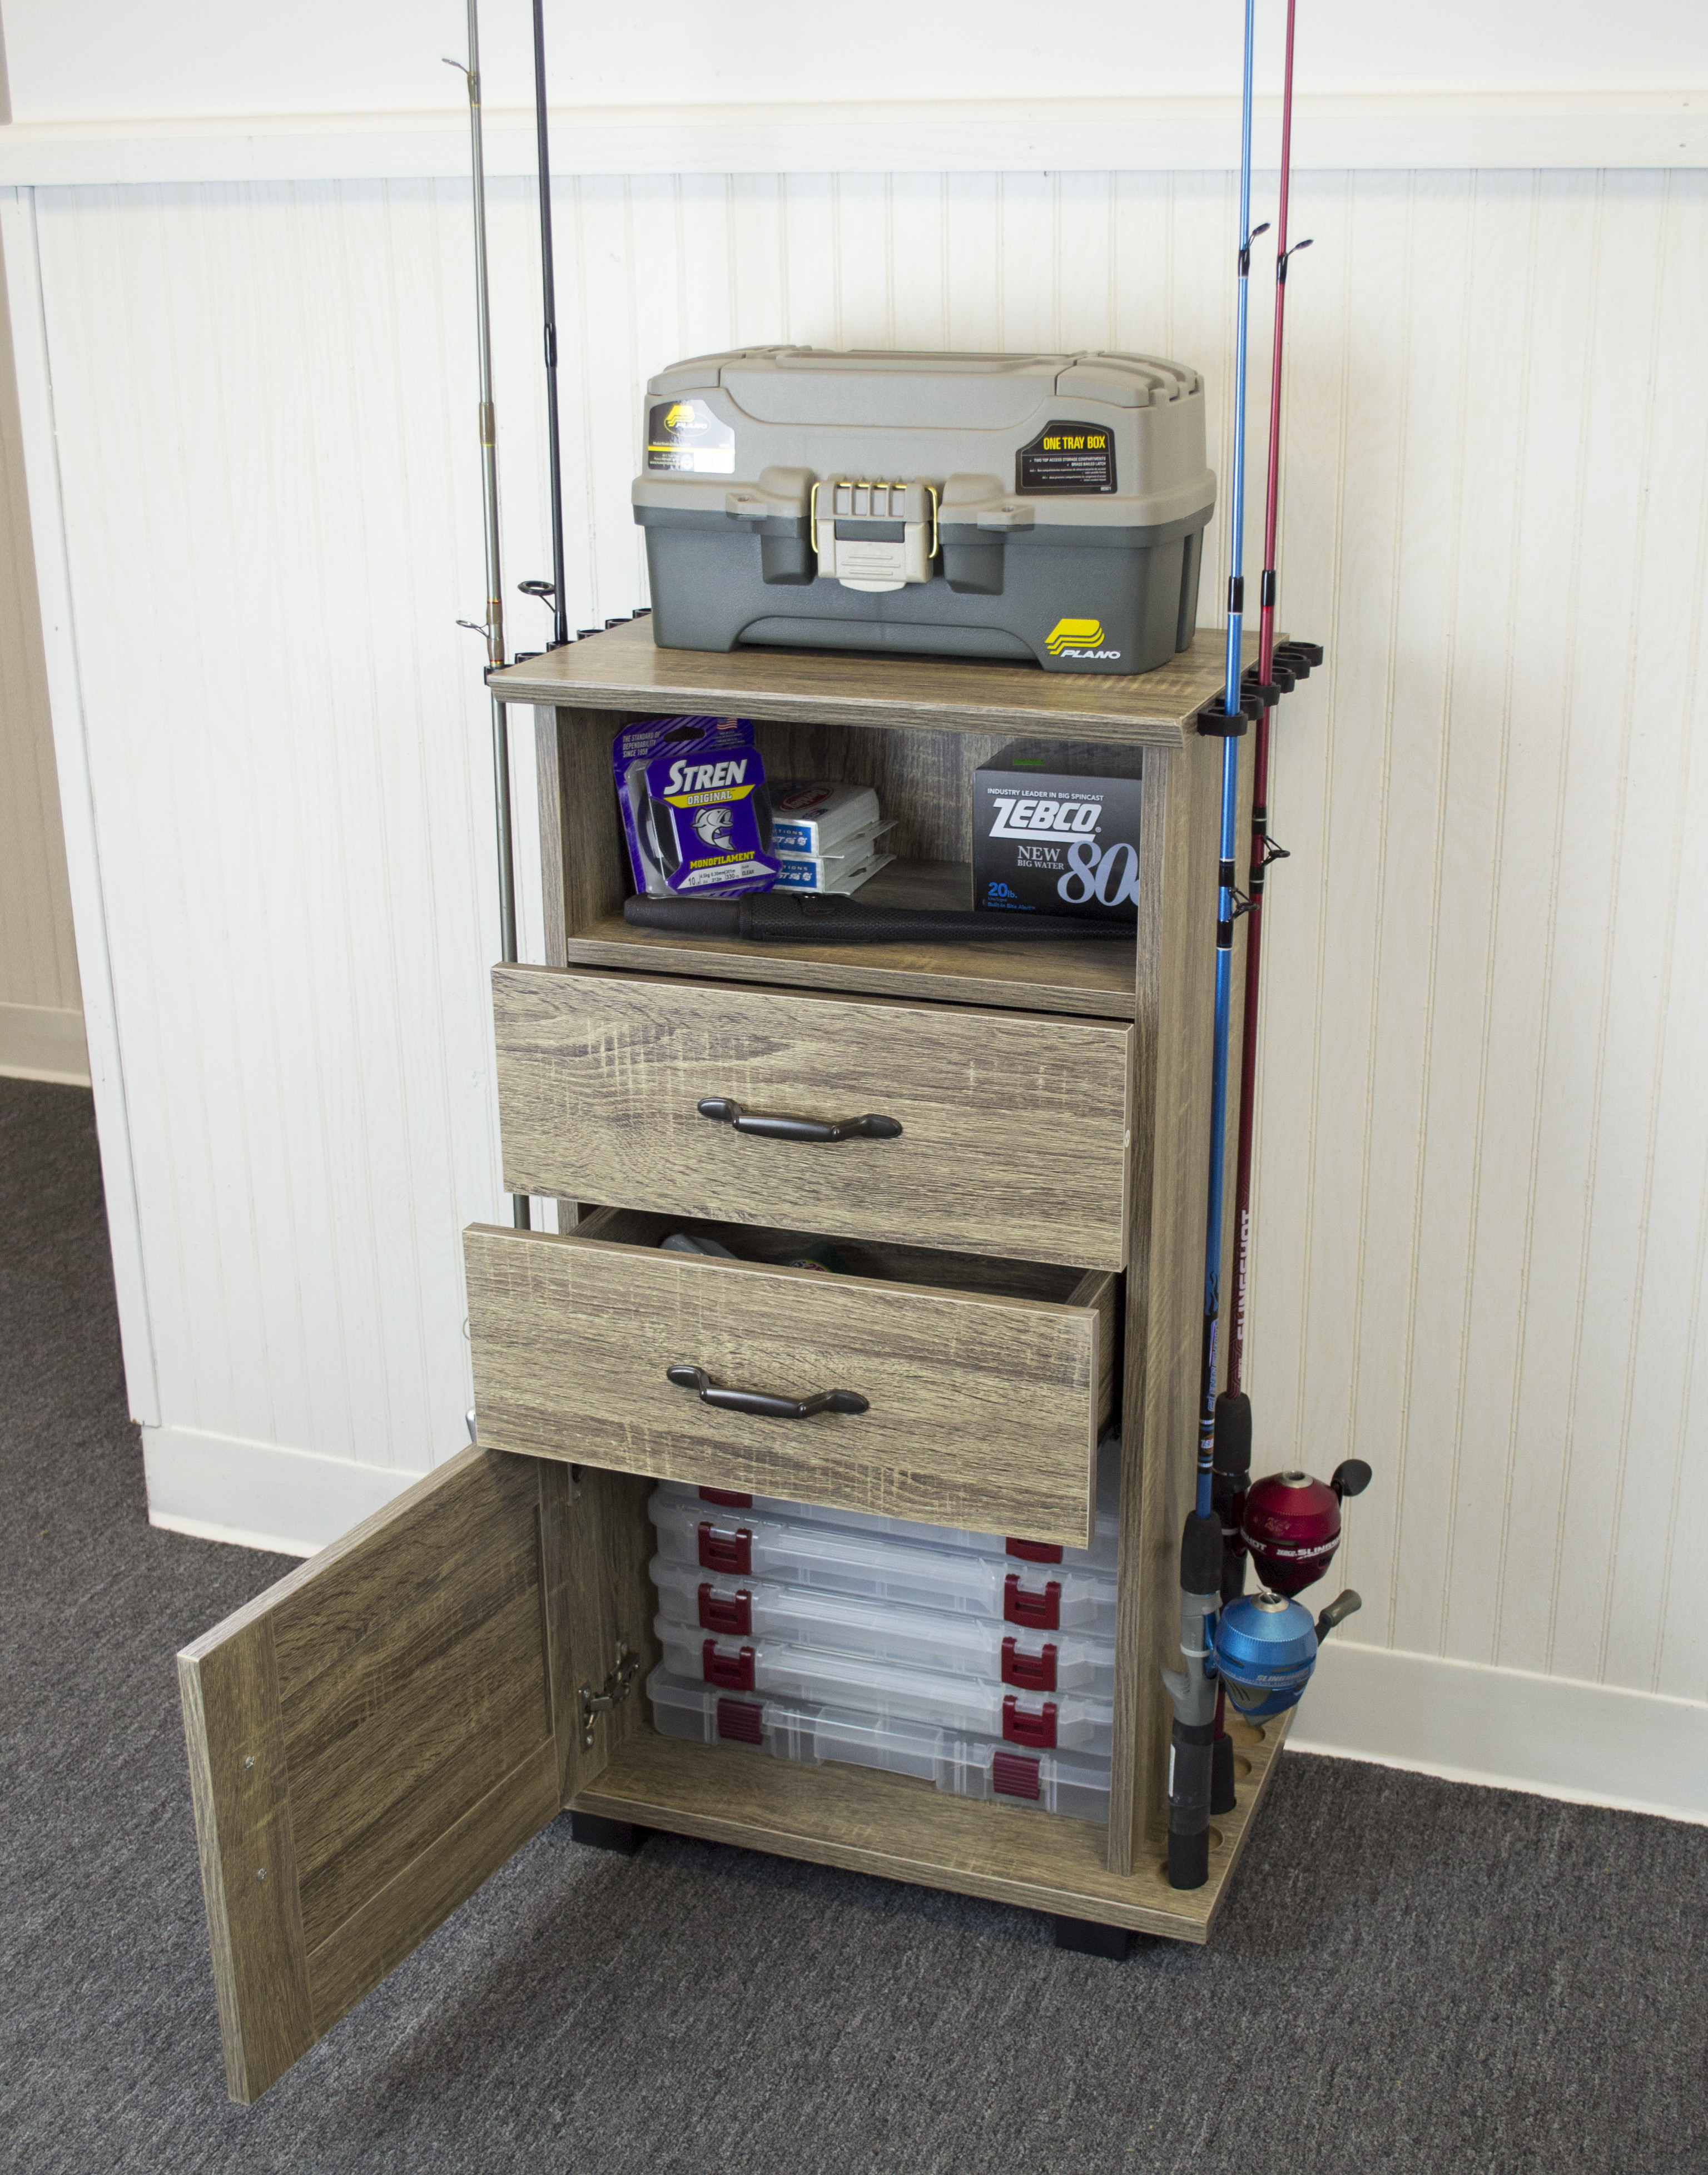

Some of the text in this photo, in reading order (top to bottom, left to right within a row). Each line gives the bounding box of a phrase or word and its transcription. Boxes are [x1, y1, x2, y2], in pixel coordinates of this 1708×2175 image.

[1044, 436, 1105, 450] ONE TRAY BOX
[1060, 649, 1121, 659] PLANO
[632, 732, 654, 742] STANDARD
[623, 739, 656, 750] DEPENDABILITY
[623, 749, 636, 758] SINCE
[663, 759, 748, 795] STREN
[687, 790, 732, 806] ORIGINAL
[1071, 793, 1104, 801] SPINCAST
[989, 798, 1102, 843] ZEBCO
[1017, 845, 1061, 862] NEW
[690, 851, 755, 869] MONOFILAMENT
[1017, 859, 1065, 870] BIG WATER
[1057, 841, 1140, 906] 80
[688, 876, 696, 886] 10
